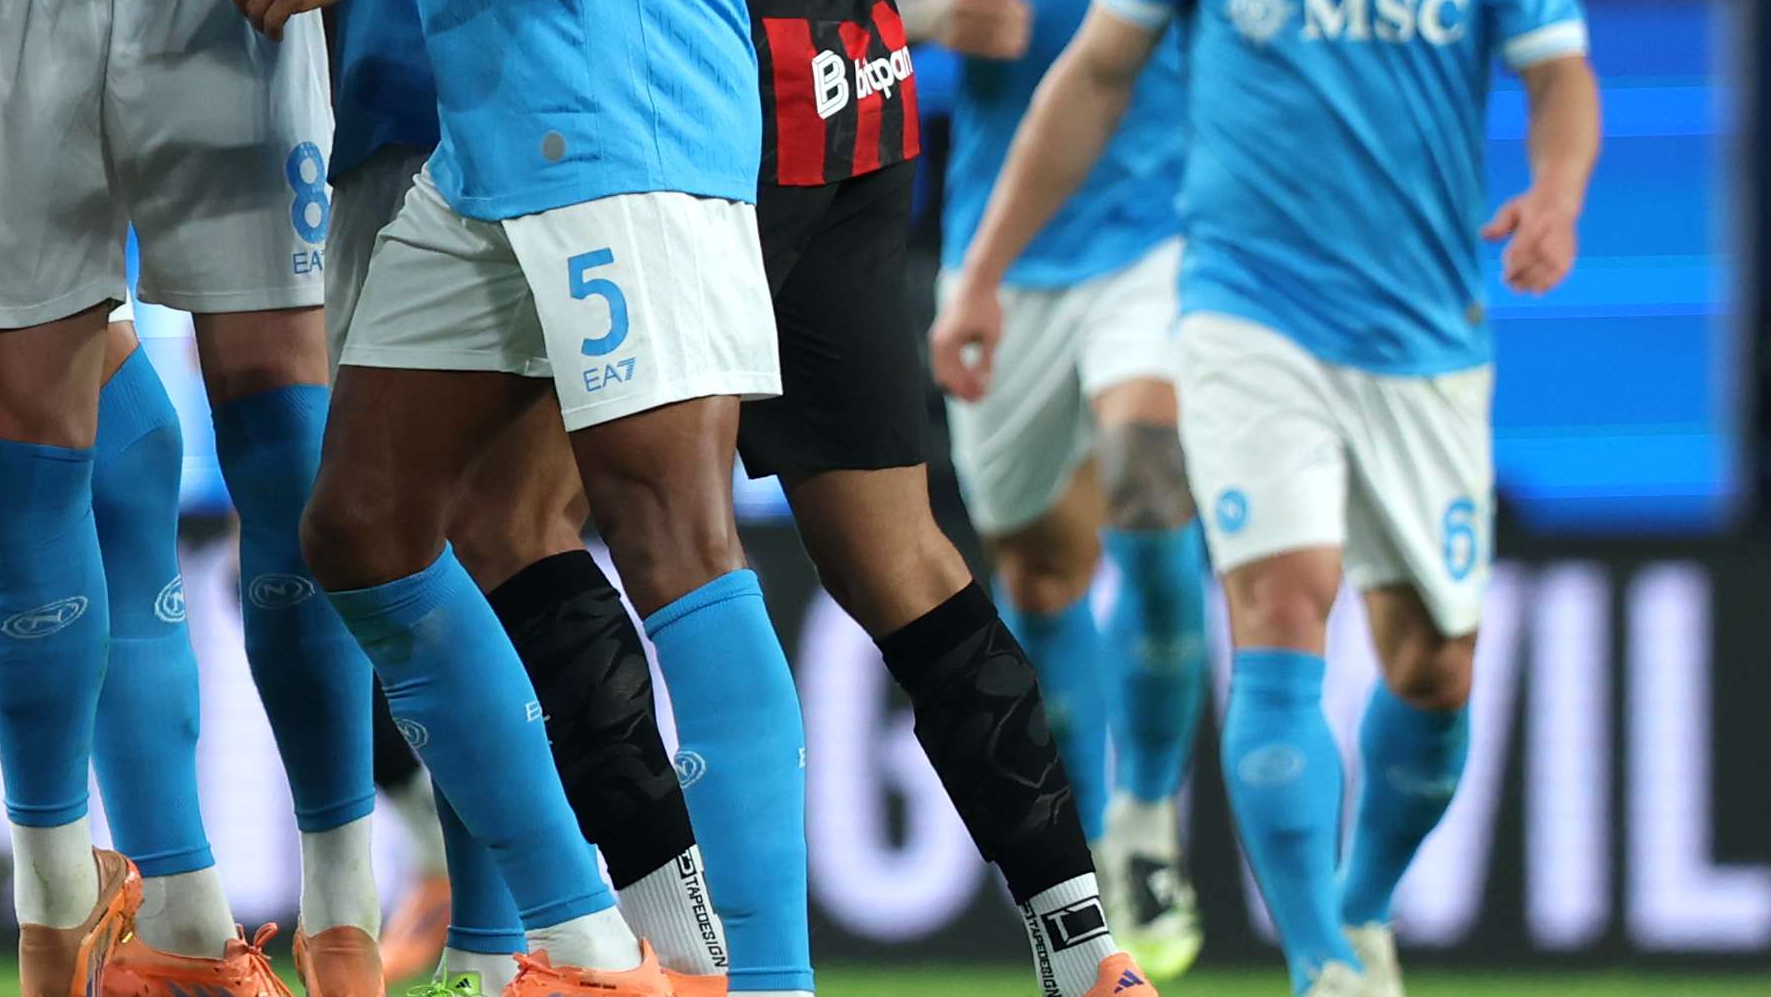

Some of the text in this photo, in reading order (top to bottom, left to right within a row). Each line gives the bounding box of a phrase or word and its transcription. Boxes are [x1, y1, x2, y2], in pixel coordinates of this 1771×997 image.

[285, 140, 332, 244] 8
[567, 246, 629, 357] 5
[582, 356, 637, 393] EA7
[1442, 496, 1477, 581] 6
[685, 875, 728, 968] TAPEDESIGN
